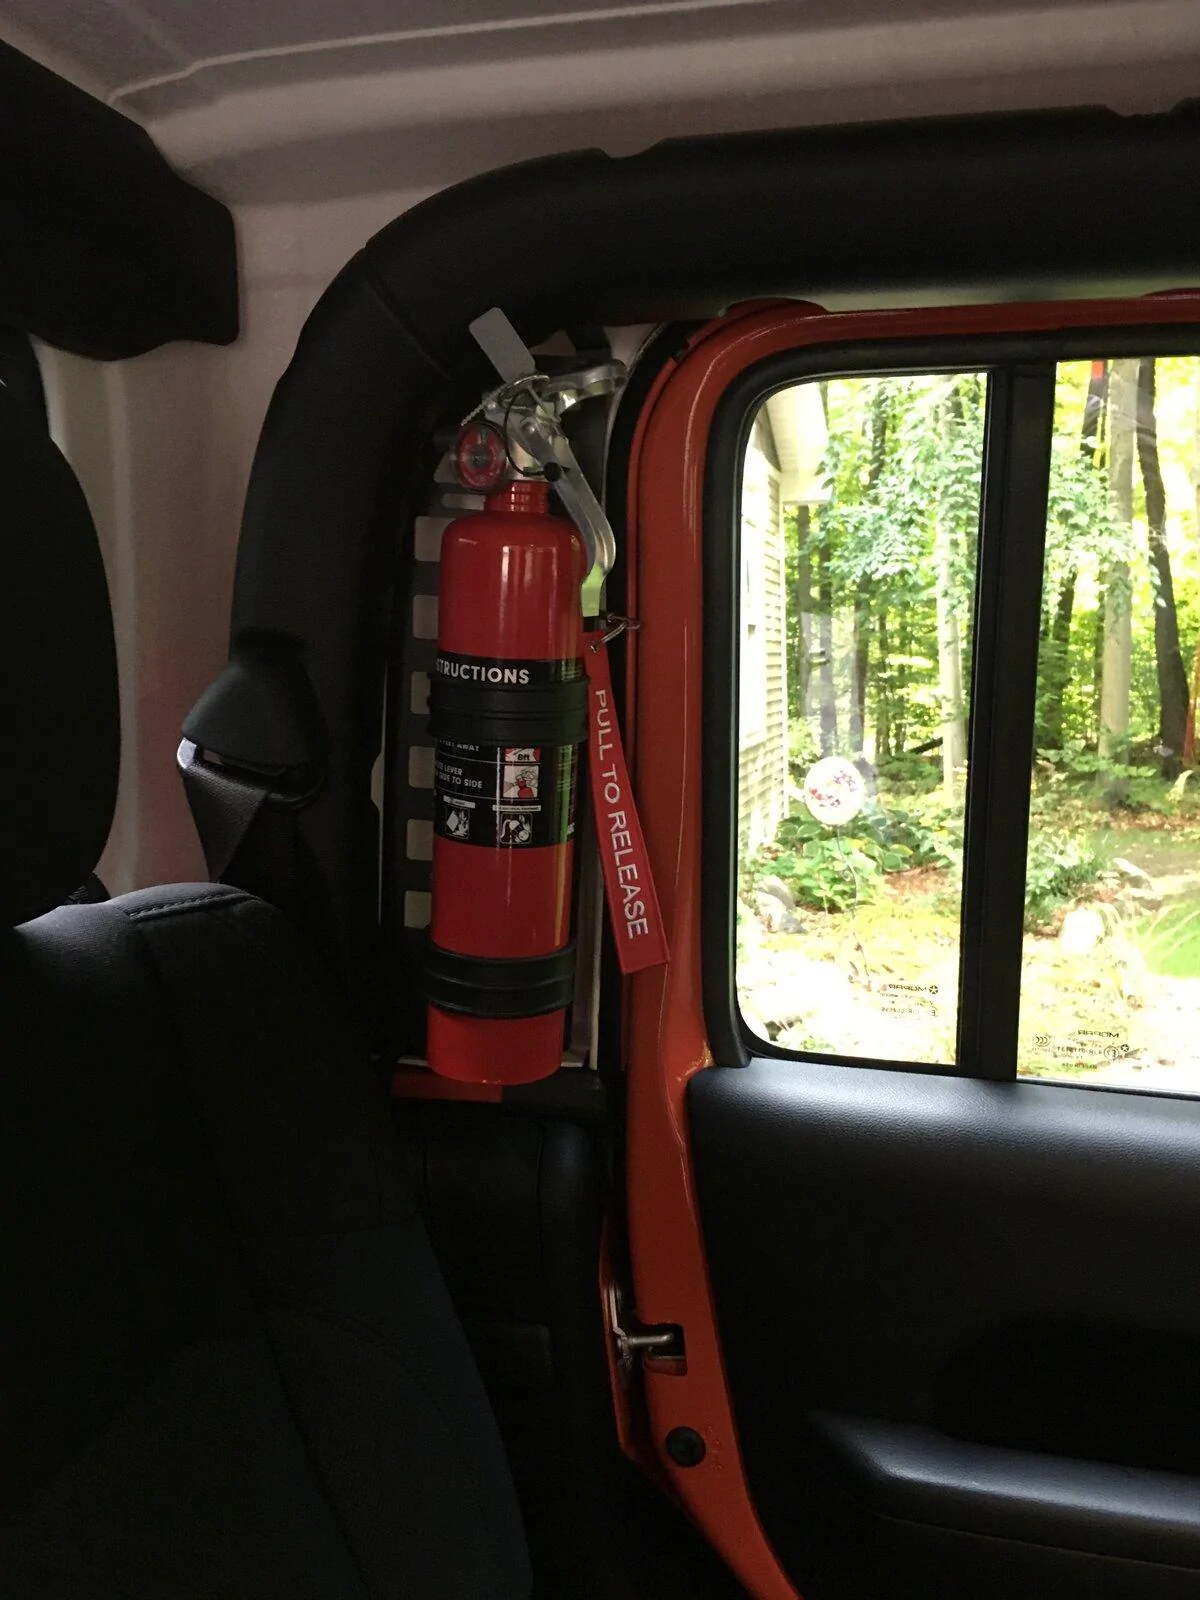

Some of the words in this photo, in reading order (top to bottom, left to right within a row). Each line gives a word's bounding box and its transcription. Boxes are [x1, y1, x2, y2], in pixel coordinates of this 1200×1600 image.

[595, 689, 613, 761] PULL
[452, 775, 462, 785] TO
[463, 778, 483, 789] SIDE
[602, 764, 621, 804] TO
[607, 810, 649, 940] RELEASE
